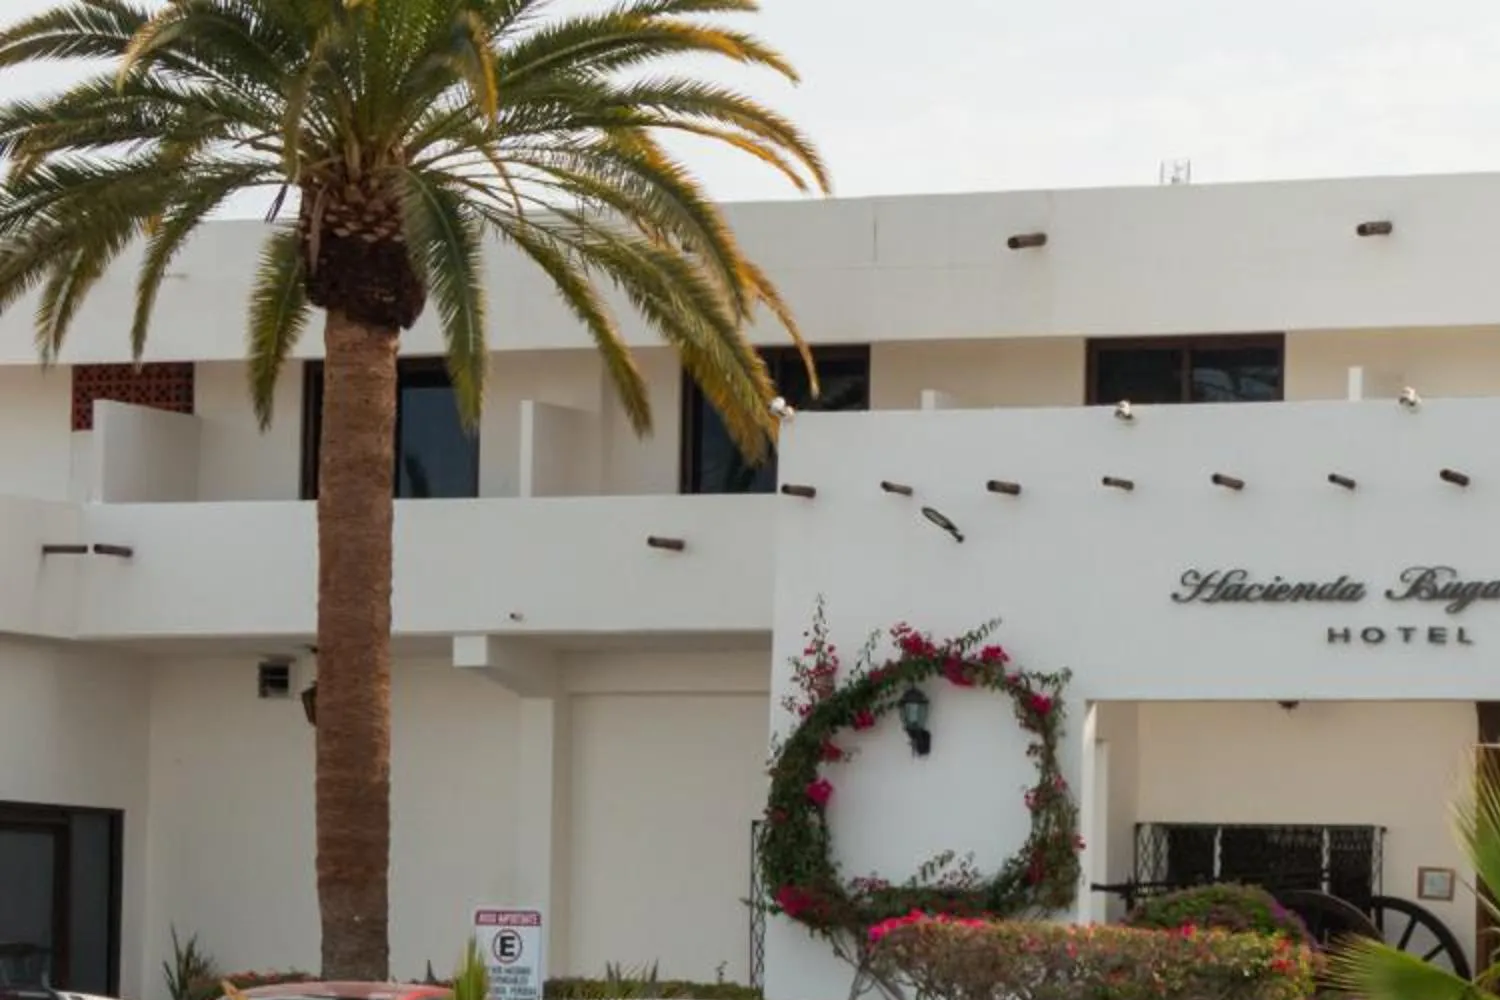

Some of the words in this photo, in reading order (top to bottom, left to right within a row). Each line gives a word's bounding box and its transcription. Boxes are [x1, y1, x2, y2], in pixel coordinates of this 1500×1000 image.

[1170, 568, 1367, 604] Hacienda
[1326, 626, 1473, 646] HOTEL
[500, 936, 515, 957] E
